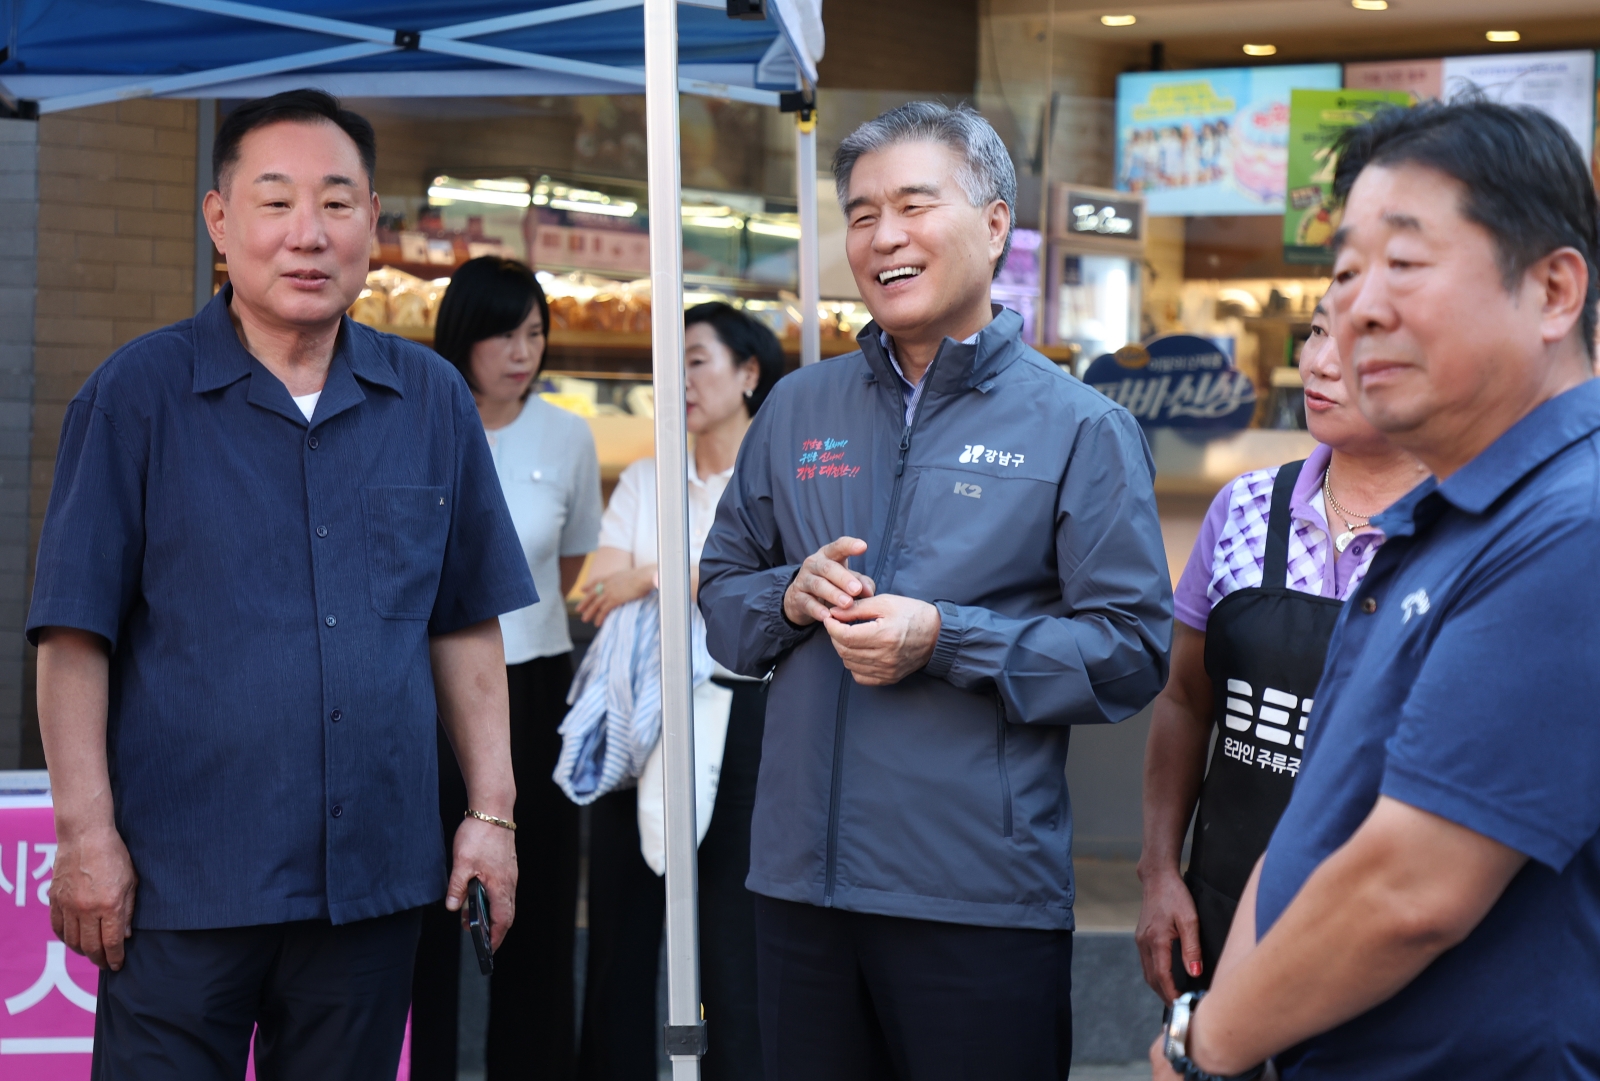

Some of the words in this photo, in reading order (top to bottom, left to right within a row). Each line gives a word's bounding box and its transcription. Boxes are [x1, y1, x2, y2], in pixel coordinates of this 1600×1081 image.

[984, 449, 1025, 468] 강남구
[796, 463, 818, 481] 강남
[953, 481, 983, 499] K2
[1224, 737, 1255, 765] 온라인
